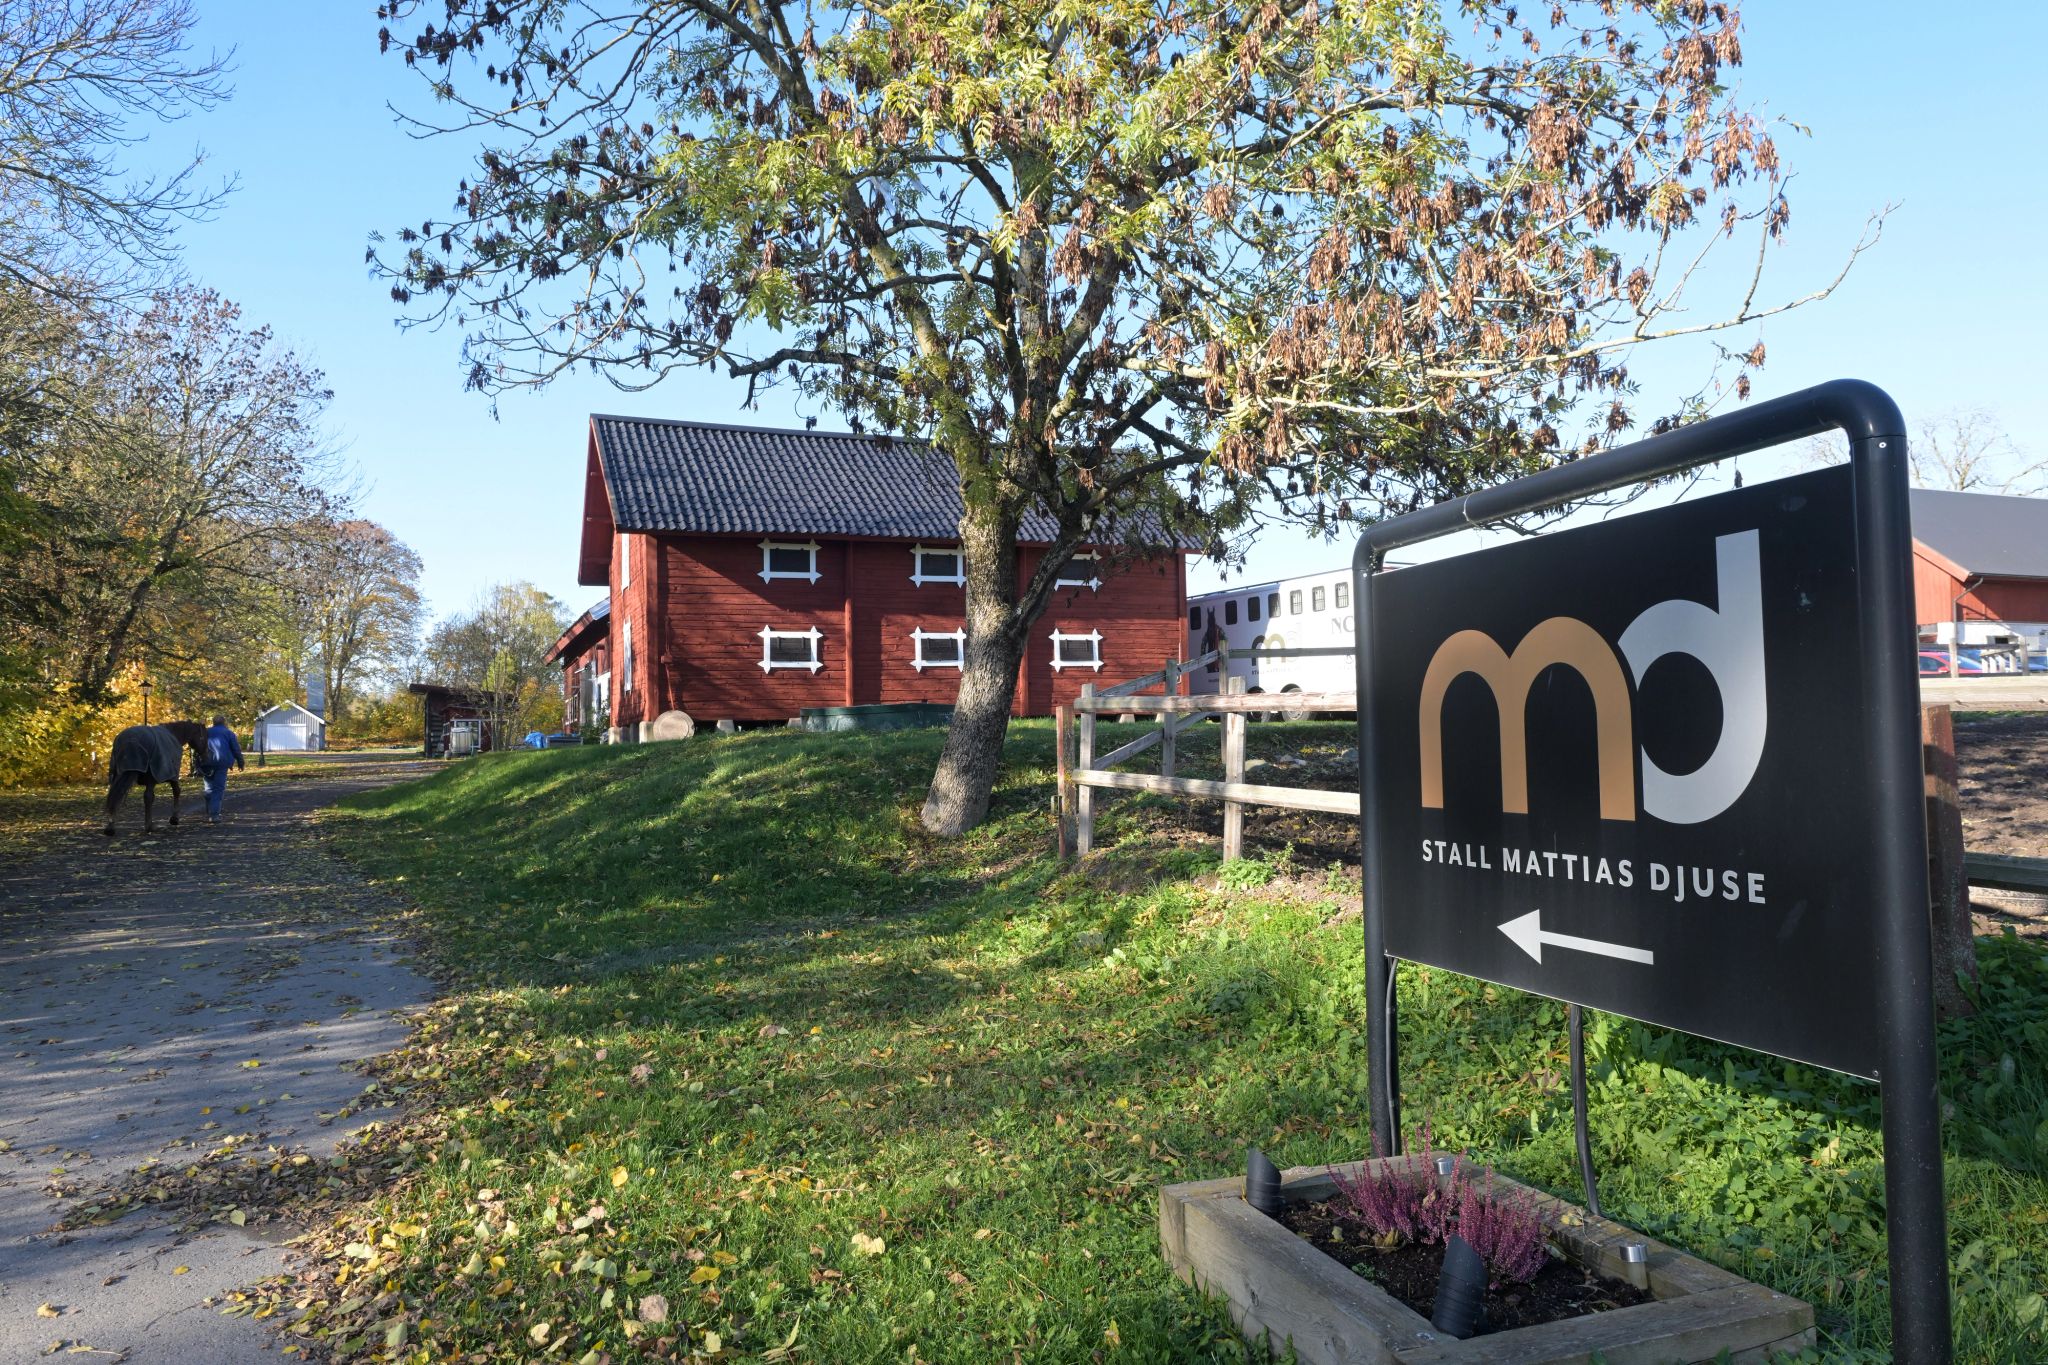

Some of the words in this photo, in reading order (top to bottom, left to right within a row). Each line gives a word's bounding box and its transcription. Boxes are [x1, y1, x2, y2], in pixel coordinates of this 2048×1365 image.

[1419, 528, 1768, 825] md
[1422, 839, 1492, 870] STALL
[1502, 847, 1634, 888] MATTIAS
[1649, 862, 1767, 904] DJUSE
